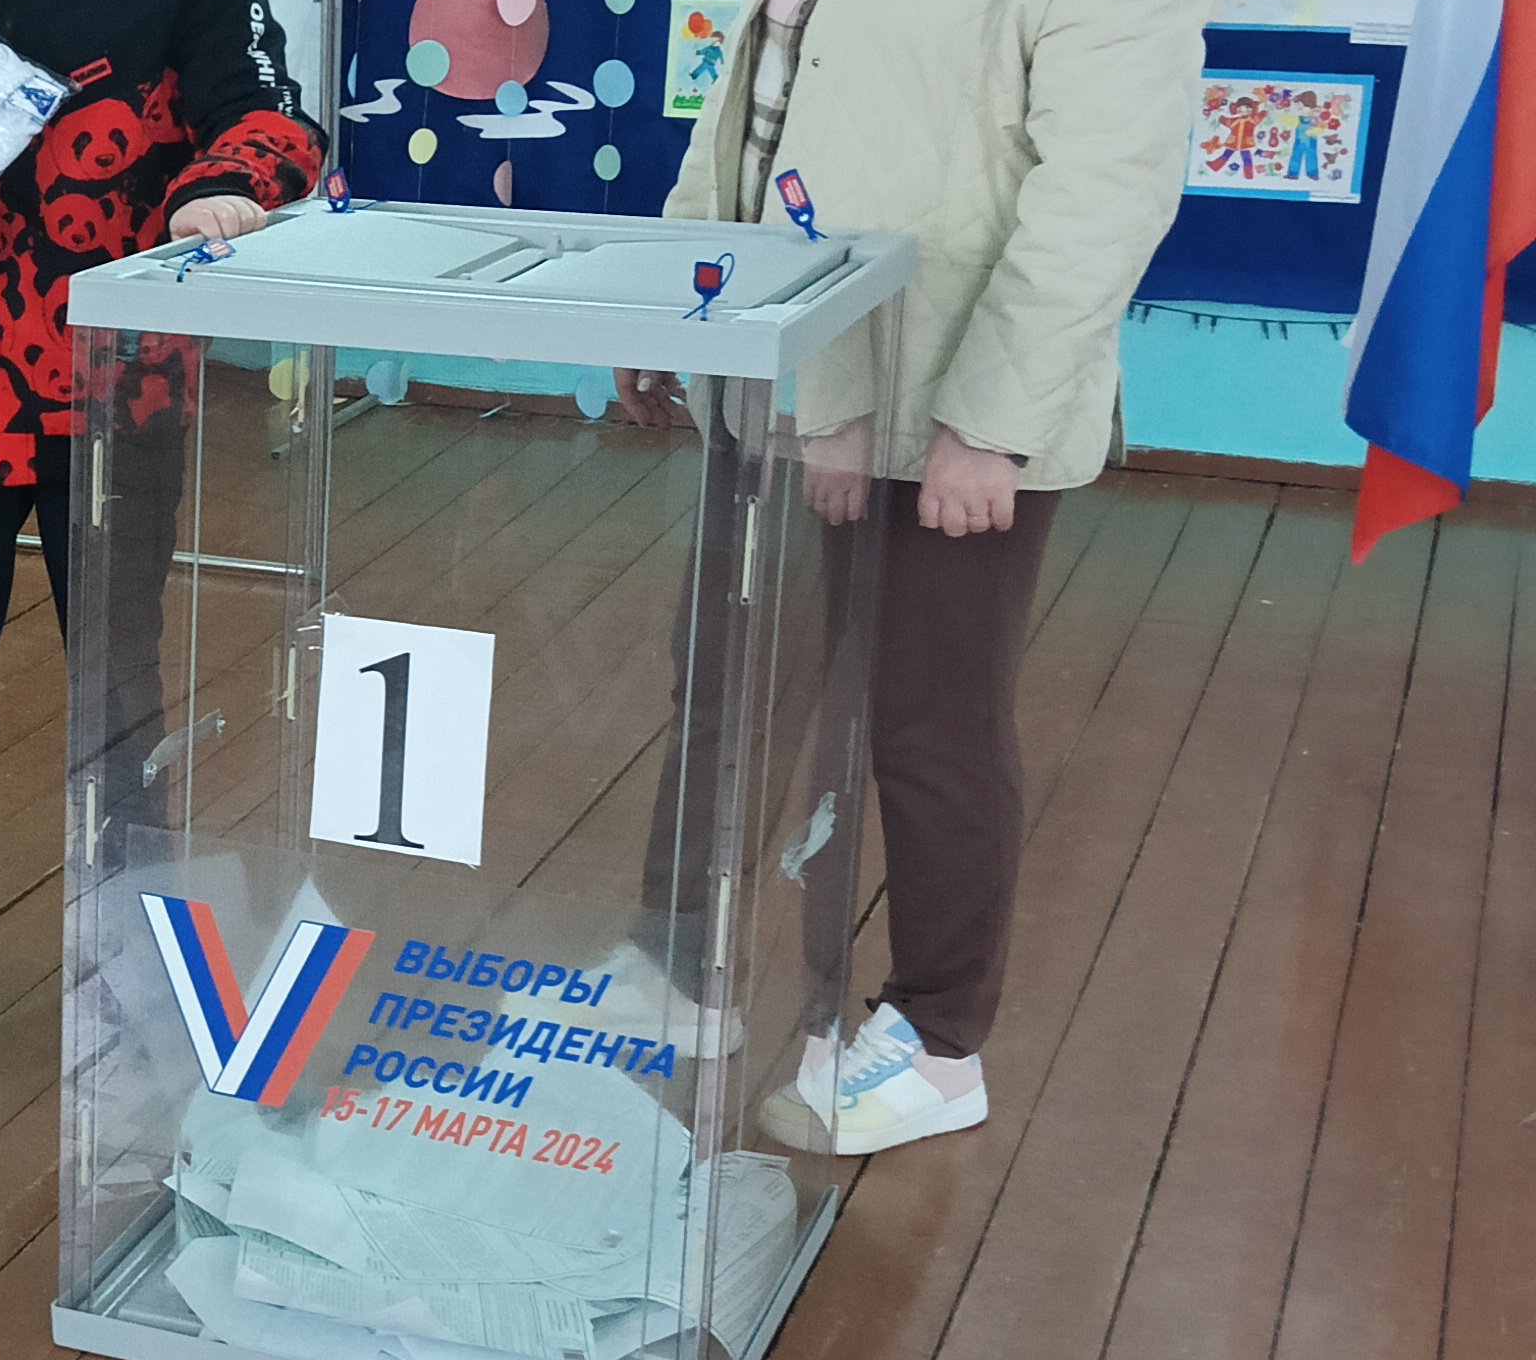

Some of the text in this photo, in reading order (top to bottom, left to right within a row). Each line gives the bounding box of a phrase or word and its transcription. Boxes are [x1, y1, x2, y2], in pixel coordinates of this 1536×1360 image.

[354, 652, 425, 850] 1
[393, 940, 613, 1007] ВЫБОРЫ
[343, 1044, 533, 1108] РОССИИ
[368, 992, 676, 1079] ПРЕЗИДЕНТА
[320, 1086, 621, 1174] 15-17 МАРТА 2024
